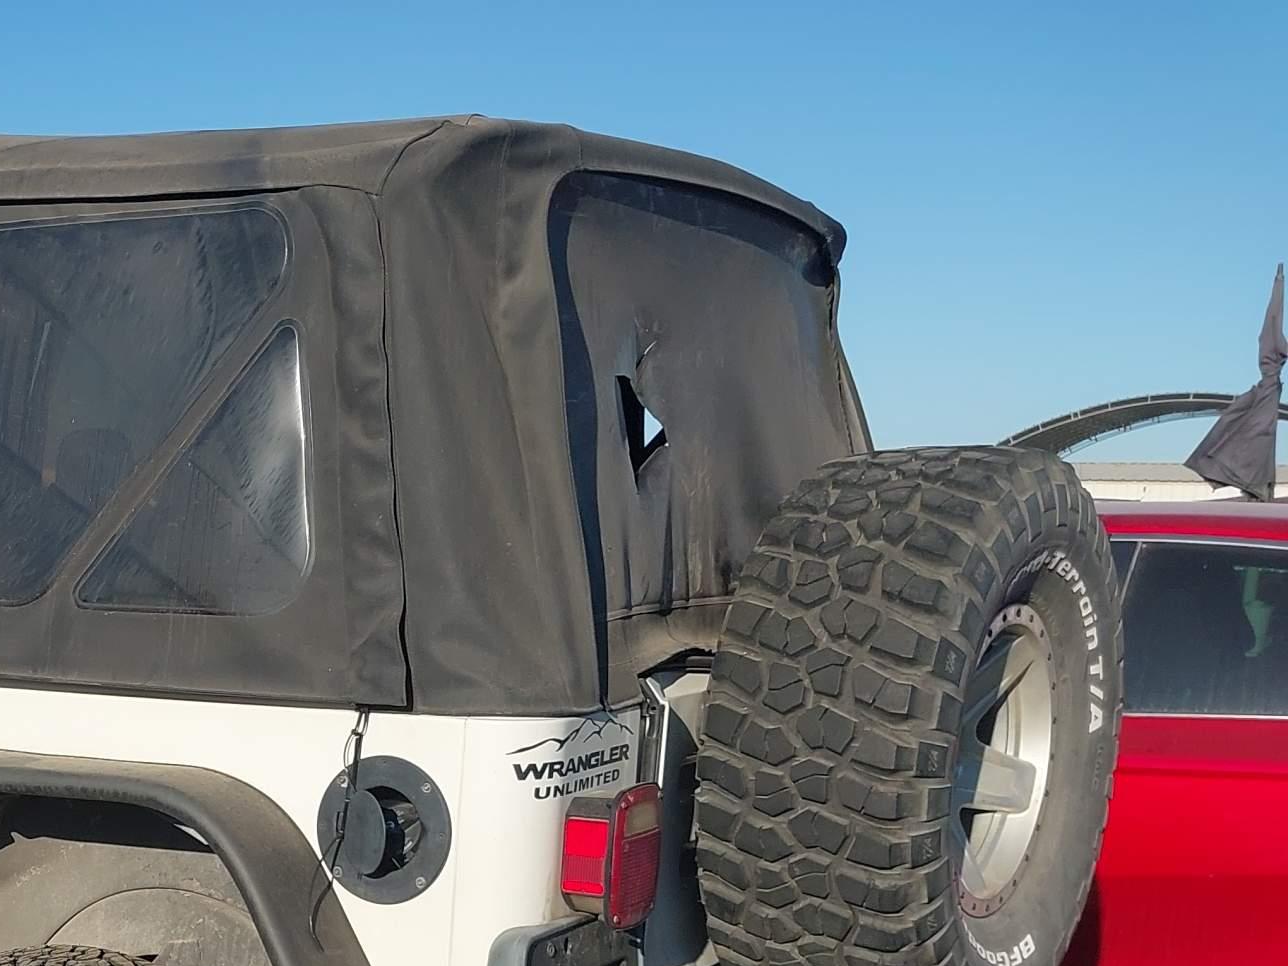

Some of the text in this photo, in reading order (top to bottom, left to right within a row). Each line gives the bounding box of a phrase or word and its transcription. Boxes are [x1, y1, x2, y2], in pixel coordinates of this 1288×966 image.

[1088, 655, 1104, 734] T/A
[512, 743, 630, 781] WRANGLER
[534, 769, 620, 800] UNLIMITED
